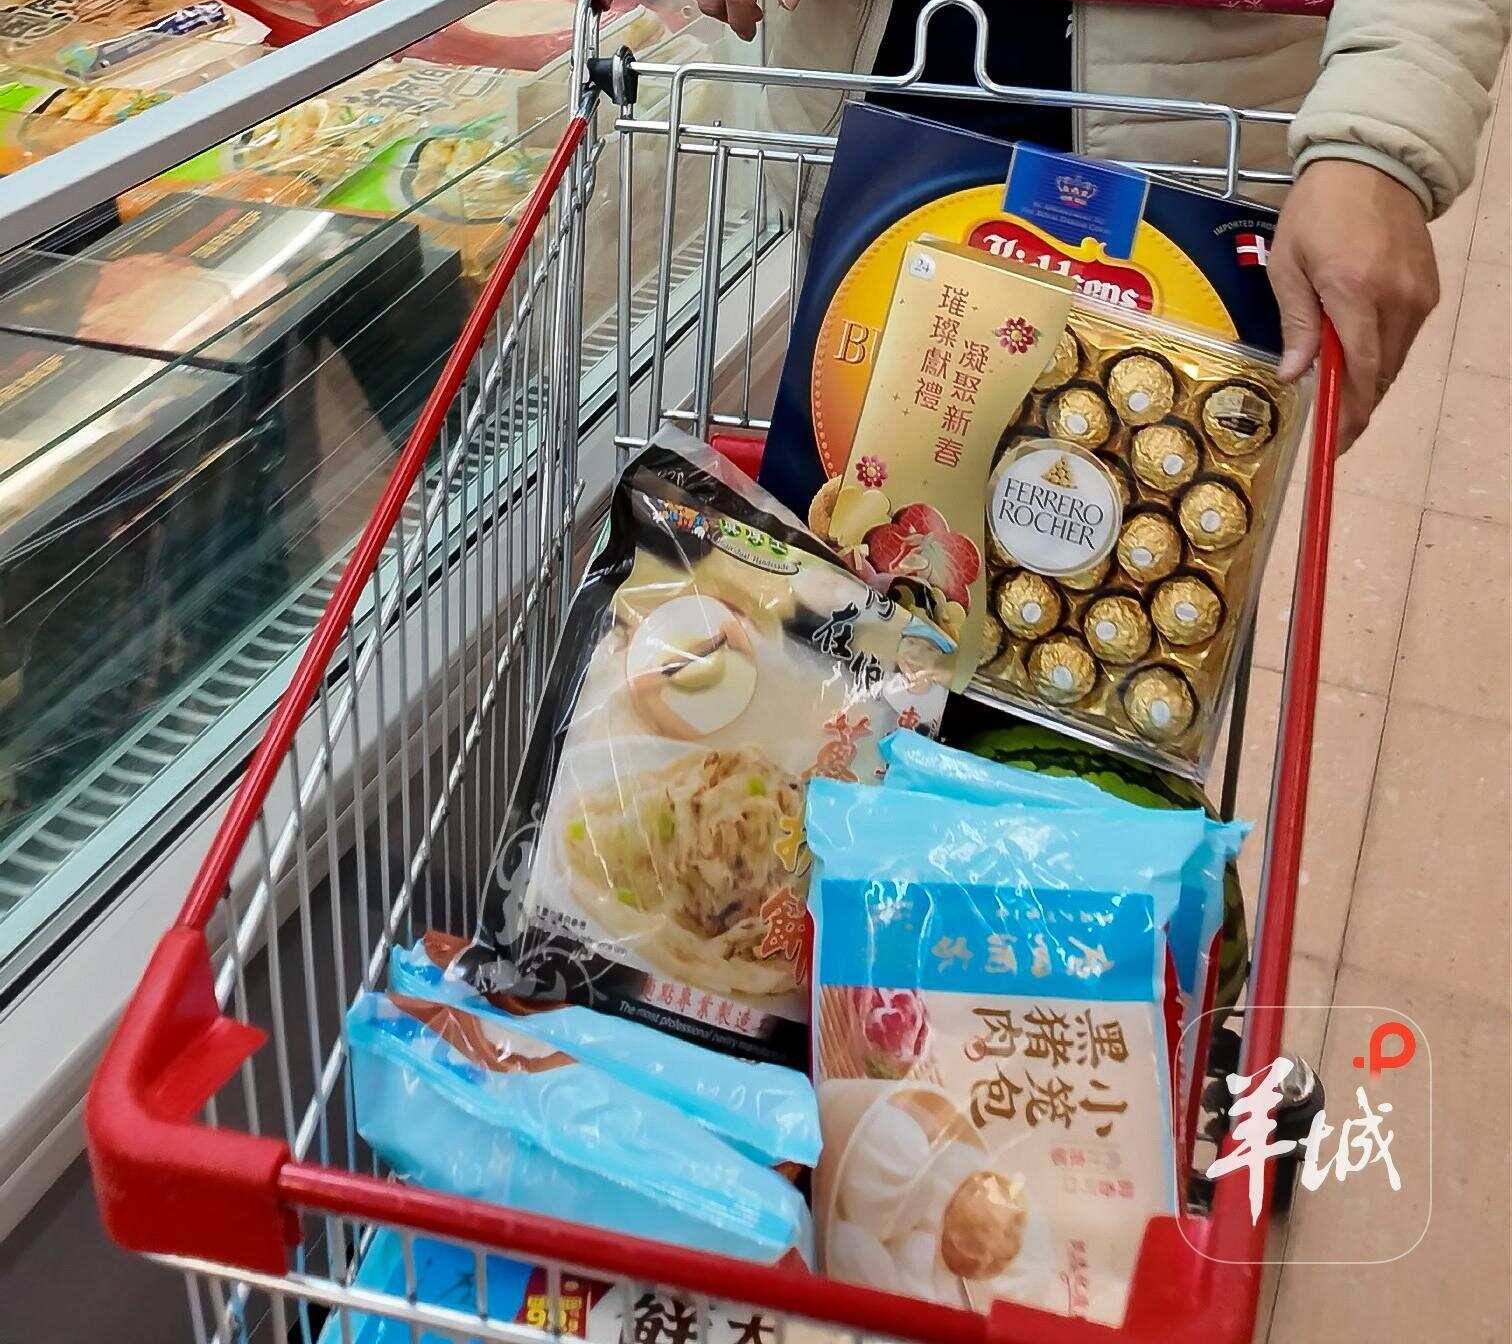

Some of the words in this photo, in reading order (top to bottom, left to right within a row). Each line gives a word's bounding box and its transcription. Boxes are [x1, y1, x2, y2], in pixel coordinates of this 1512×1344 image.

[1213, 219, 1255, 237] IMPORTED
[914, 284, 970, 412] 璀璨獻禮
[934, 340, 990, 468] 凝聚新春
[998, 499, 1096, 551] ROCHER
[1004, 478, 1104, 526] FERRERO
[971, 1003, 1130, 1069] 黑猪肉
[970, 1062, 1129, 1138] 小笼包
